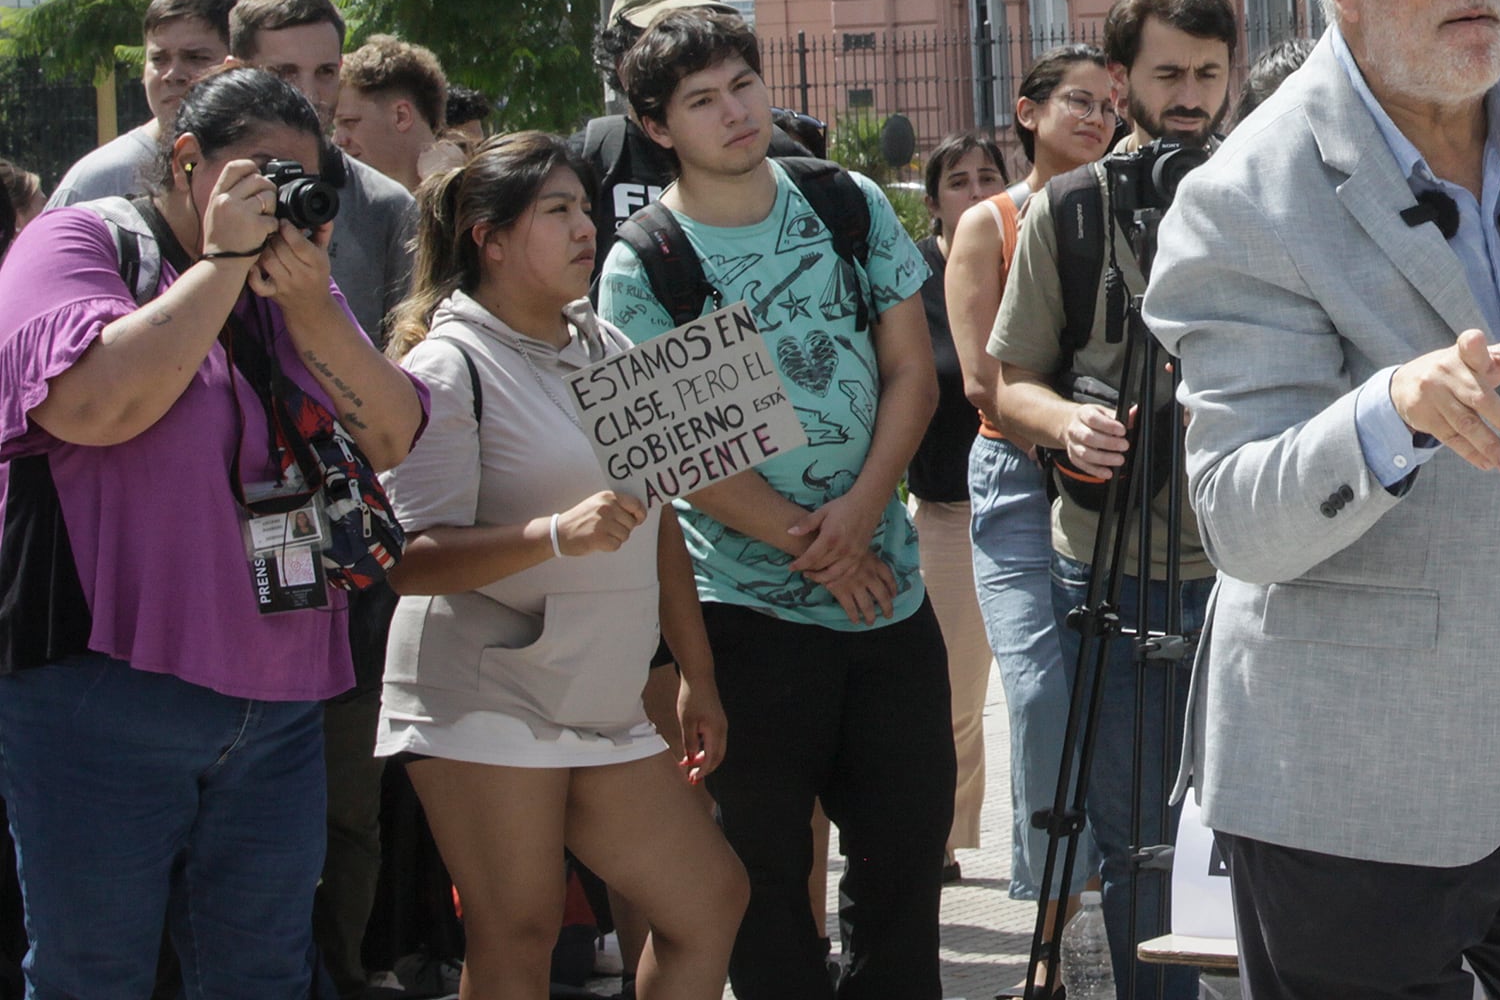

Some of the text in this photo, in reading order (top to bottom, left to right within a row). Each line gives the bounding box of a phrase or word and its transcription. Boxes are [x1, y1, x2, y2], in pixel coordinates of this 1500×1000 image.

[571, 306, 758, 411] ESTAMOS EN
[594, 352, 773, 447] CLASE, PERO EL
[753, 386, 787, 413] ESTÁ
[644, 423, 779, 508] AUSENTE
